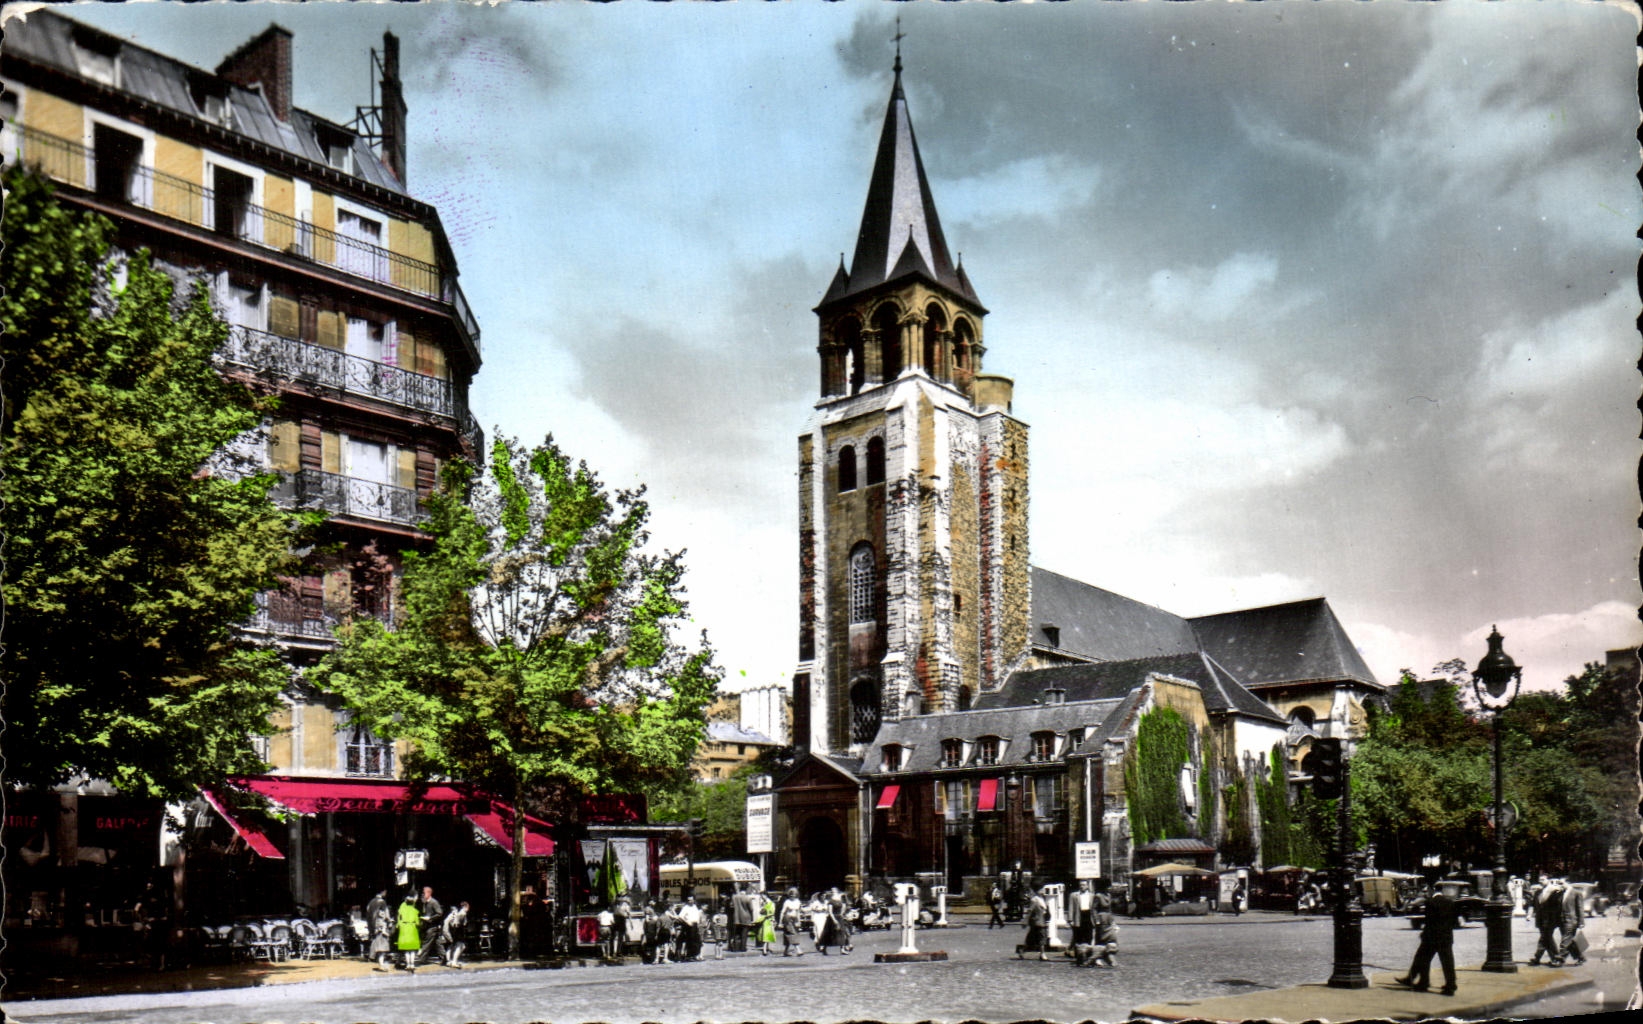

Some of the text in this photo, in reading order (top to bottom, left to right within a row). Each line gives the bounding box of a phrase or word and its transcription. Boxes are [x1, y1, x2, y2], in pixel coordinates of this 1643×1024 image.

[391, 799, 468, 816] agots
[659, 878, 682, 888] UBLES
[684, 877, 711, 888] DBOIS
